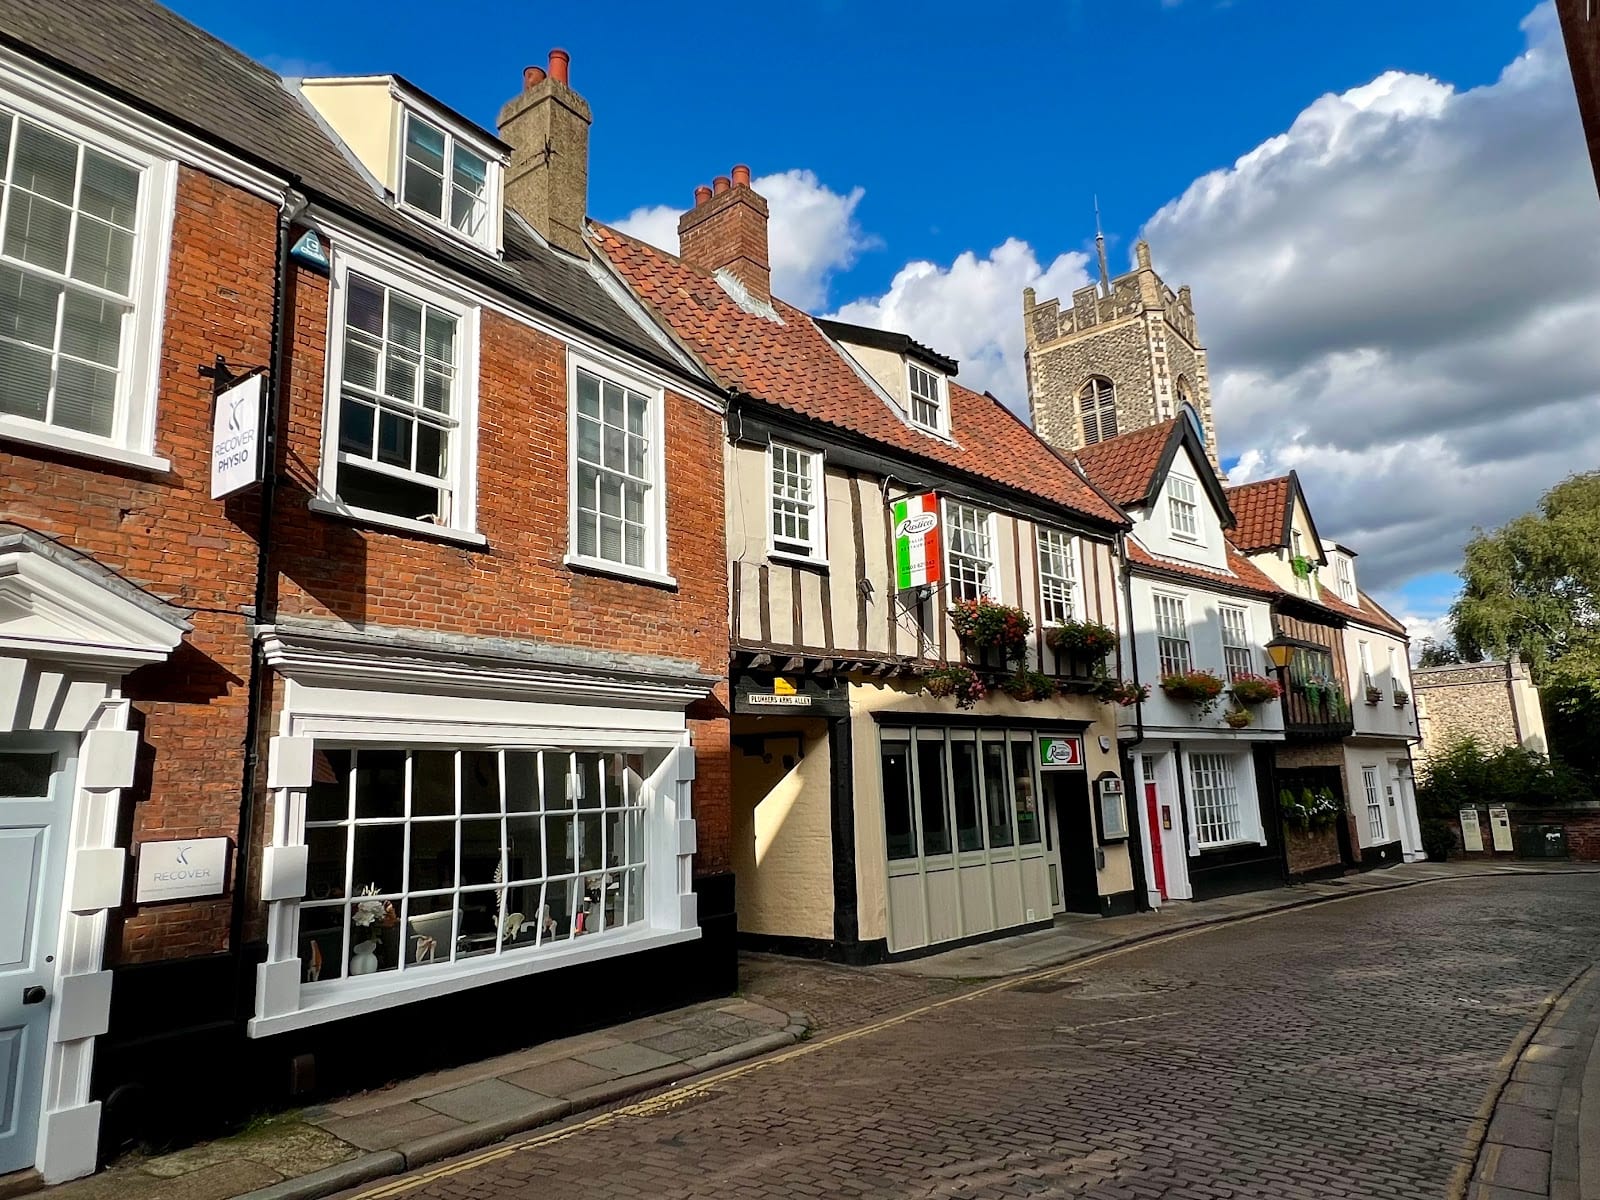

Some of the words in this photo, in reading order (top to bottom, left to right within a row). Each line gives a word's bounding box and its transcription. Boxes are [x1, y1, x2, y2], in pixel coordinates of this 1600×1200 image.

[215, 429, 254, 456] RECOVER
[218, 449, 248, 472] PHYSIO
[898, 519, 933, 536] Rustica
[795, 697, 810, 705] ALLEY
[153, 868, 210, 882] RECOVER
